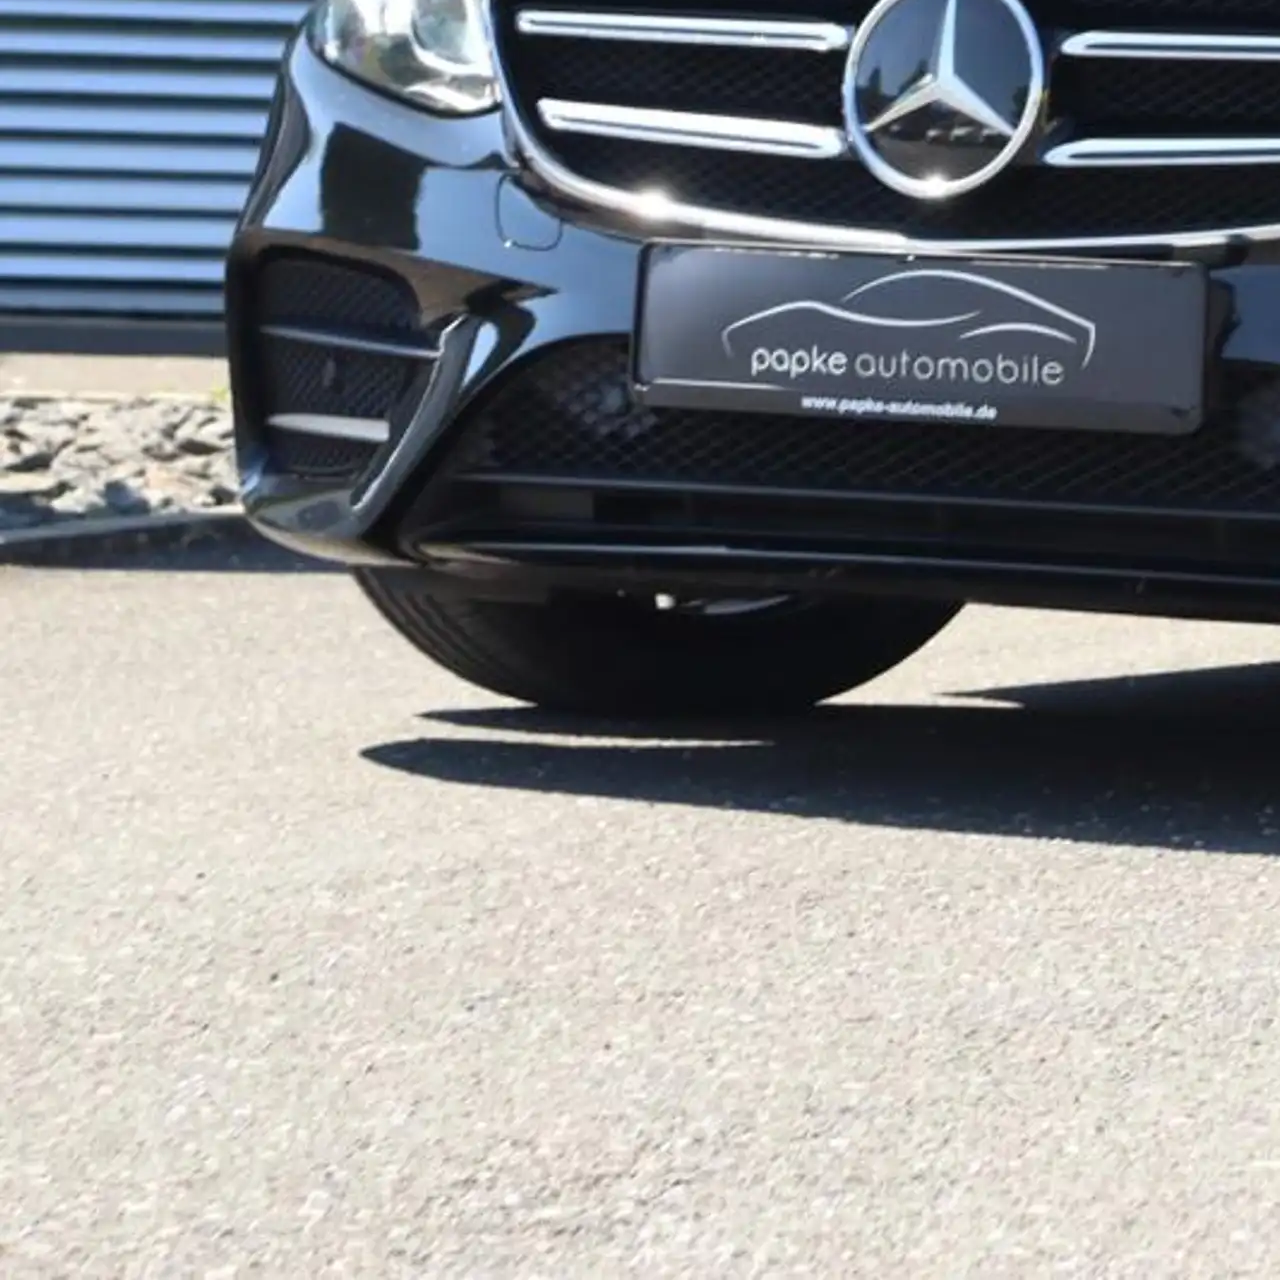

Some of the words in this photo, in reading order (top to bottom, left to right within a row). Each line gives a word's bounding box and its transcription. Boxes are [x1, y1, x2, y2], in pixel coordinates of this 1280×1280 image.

[751, 345, 848, 379] papke
[854, 349, 1065, 385] automobile
[801, 396, 998, 420] www.papke-automobile.de
